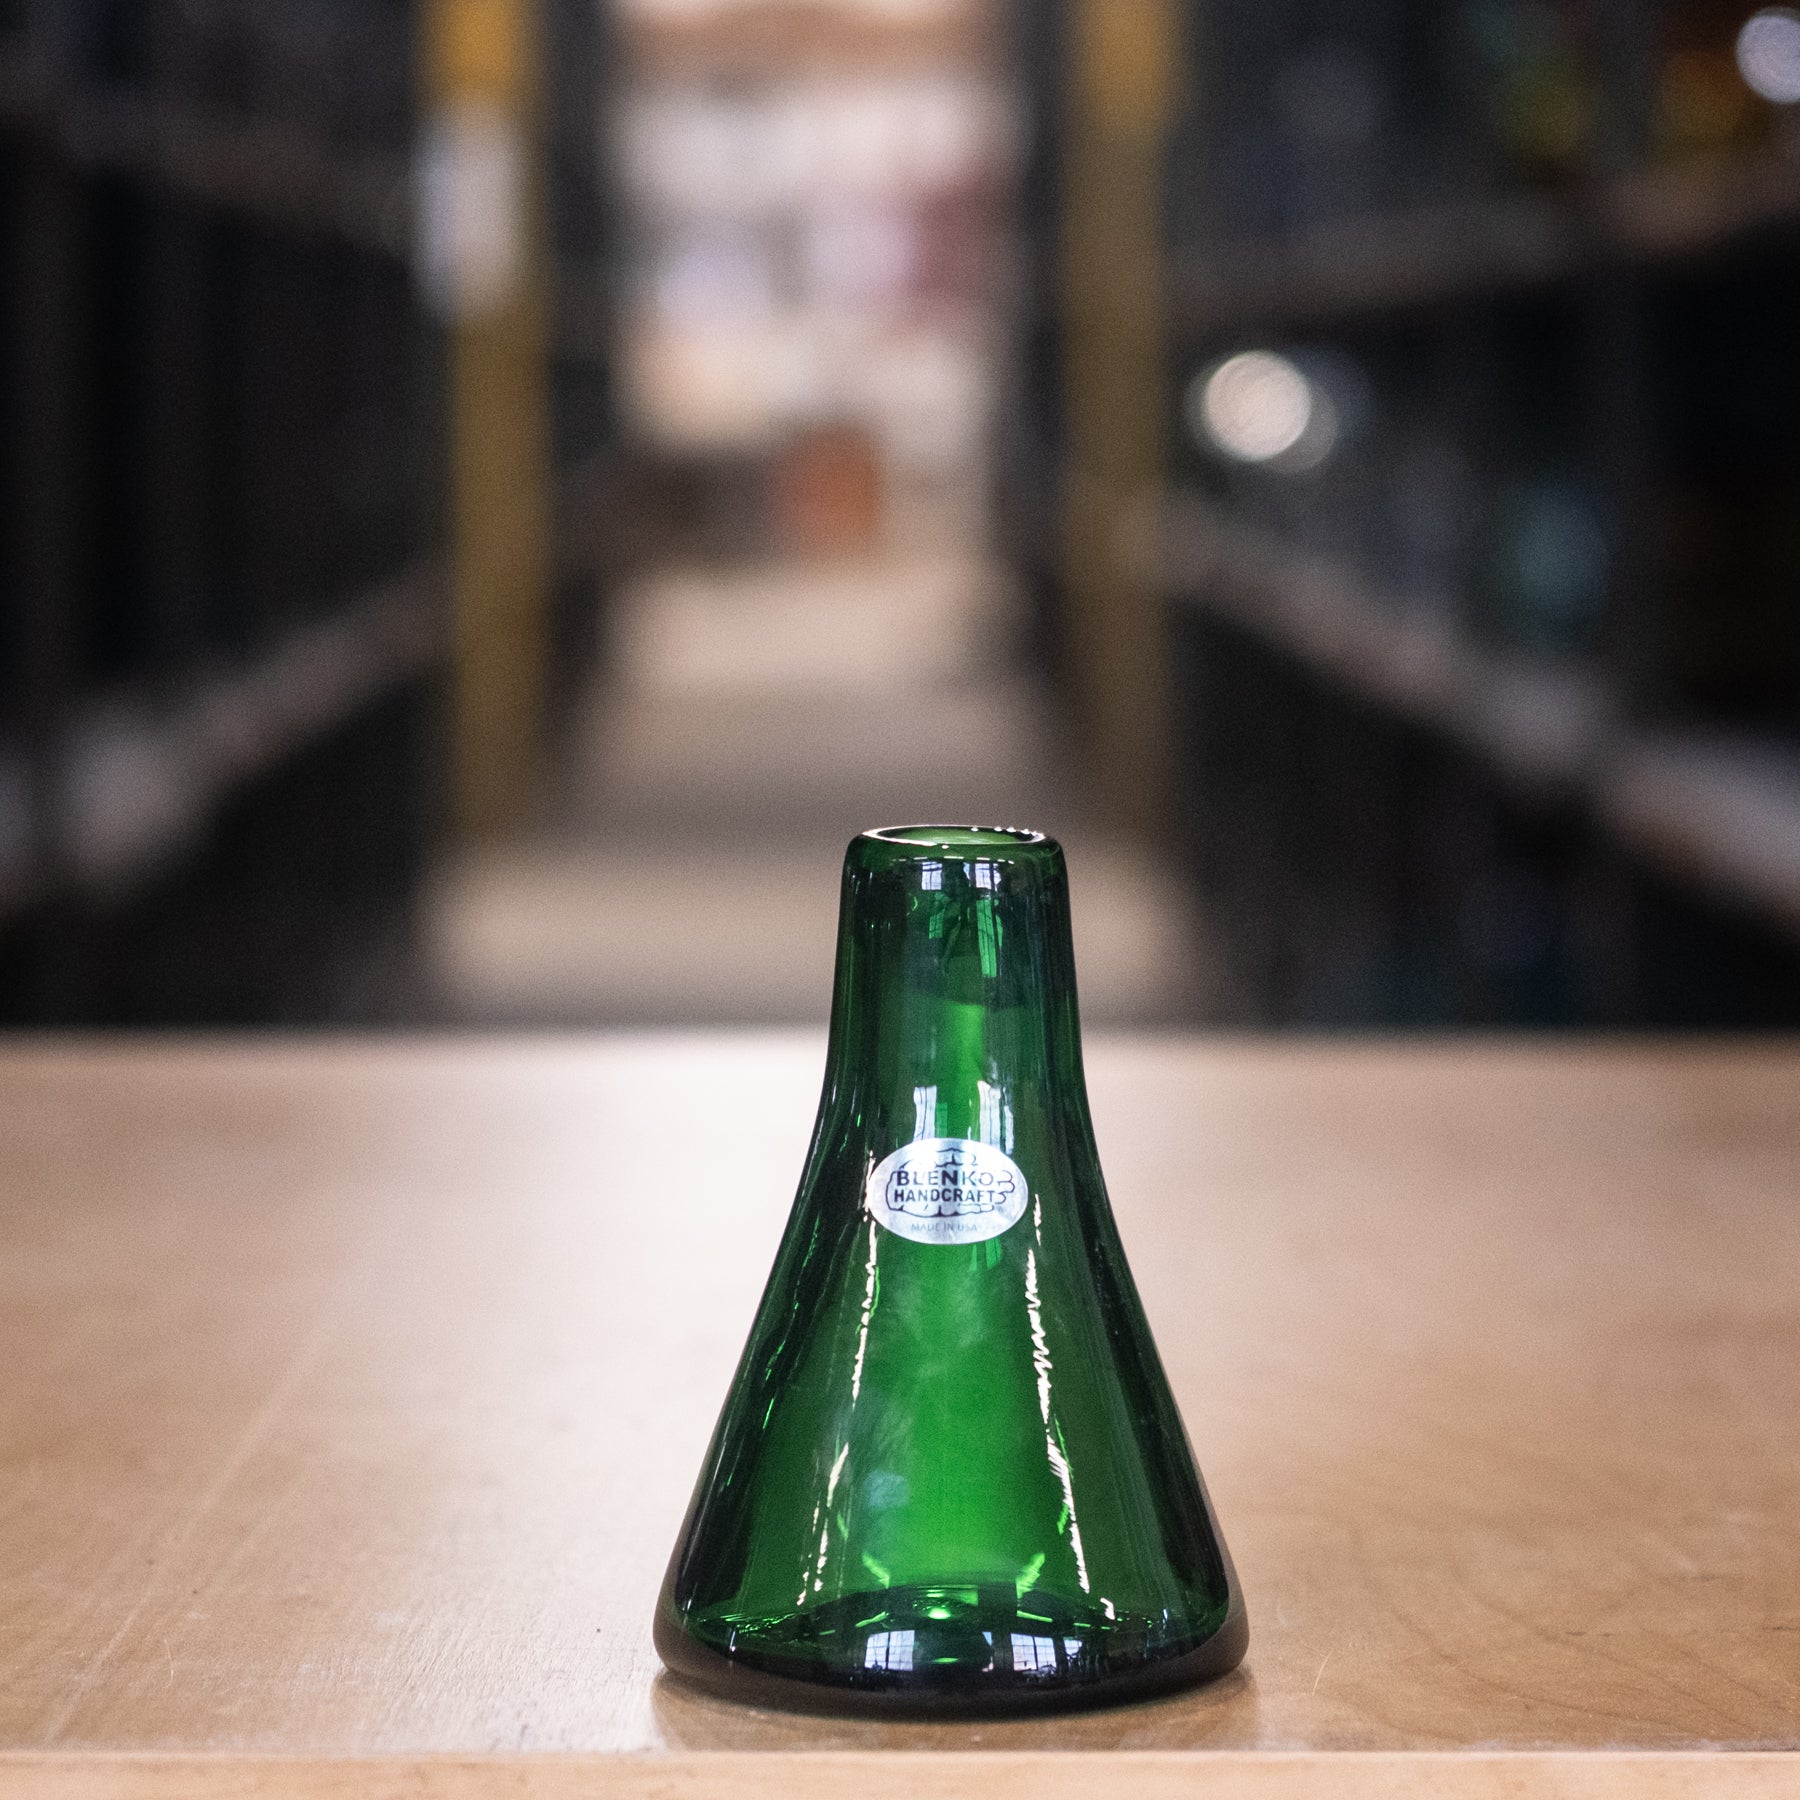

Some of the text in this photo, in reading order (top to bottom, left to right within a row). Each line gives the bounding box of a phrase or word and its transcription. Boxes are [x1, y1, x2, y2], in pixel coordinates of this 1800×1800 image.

[896, 1169, 994, 1186] BLENKO
[894, 1188, 994, 1203] HANDCRAFT
[911, 1223, 978, 1232] MADE IN USA
